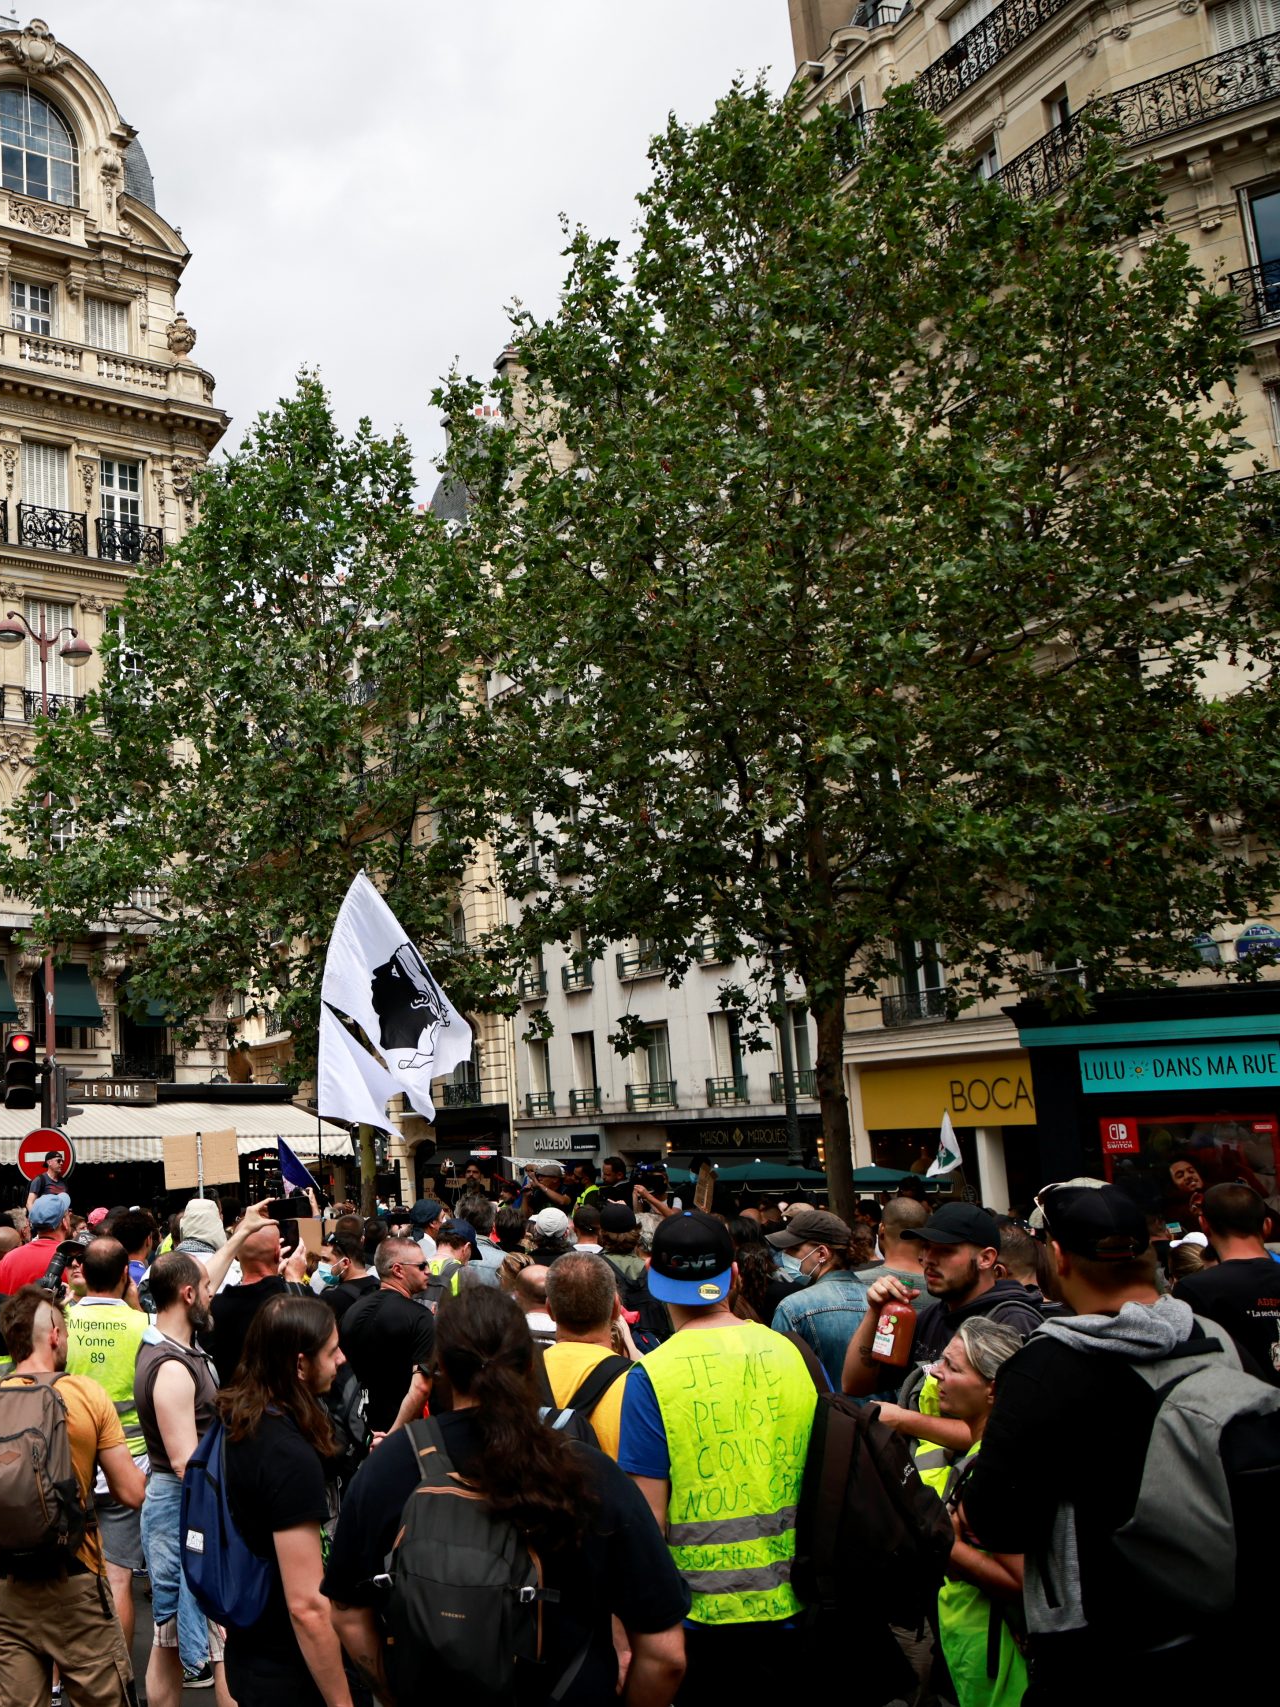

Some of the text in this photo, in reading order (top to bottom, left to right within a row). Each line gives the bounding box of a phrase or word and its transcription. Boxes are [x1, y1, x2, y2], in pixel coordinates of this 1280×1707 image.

[1083, 1053, 1279, 1081] LULU DANS MA RUE
[84, 1084, 140, 1097] LE DOME
[949, 1076, 1034, 1112] BOCA
[69, 1318, 127, 1333] Migennes
[76, 1334, 116, 1348] Yonne
[90, 1351, 106, 1364] 89
[674, 1350, 782, 1390] JE NE
[693, 1397, 786, 1443] PENSE
[697, 1431, 773, 1479] COVID
[684, 1482, 750, 1520] NOUS
